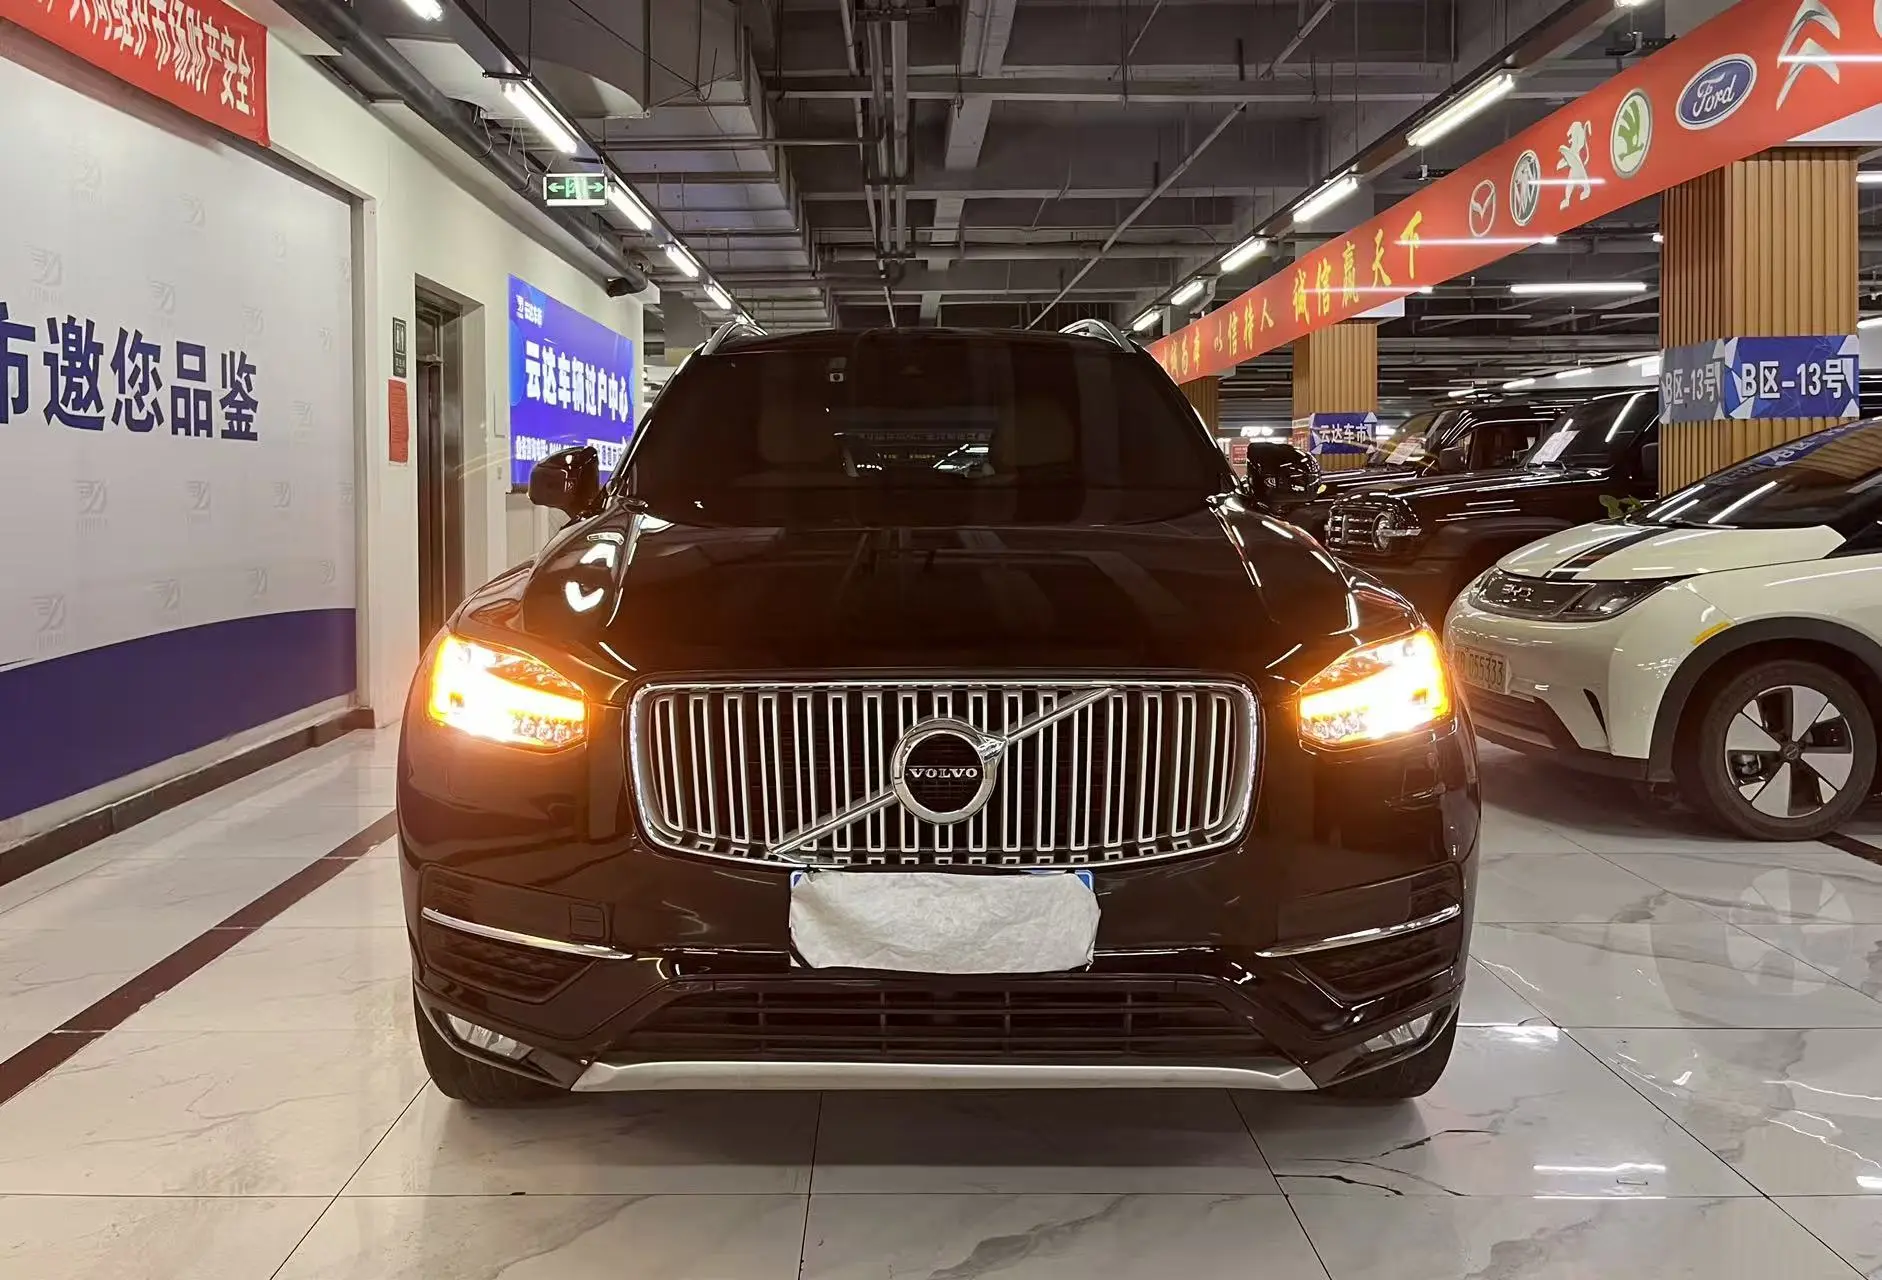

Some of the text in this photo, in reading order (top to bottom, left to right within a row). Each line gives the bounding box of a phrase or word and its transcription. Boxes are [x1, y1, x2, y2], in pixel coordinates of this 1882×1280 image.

[1692, 71, 1737, 117] Ford
[525, 339, 629, 423] 云达车辆过户中心
[1665, 363, 1716, 405] B区-13号
[1741, 359, 1845, 399] B区-13号
[1318, 423, 1368, 444] 云达车市
[909, 766, 978, 779] VOLVO
